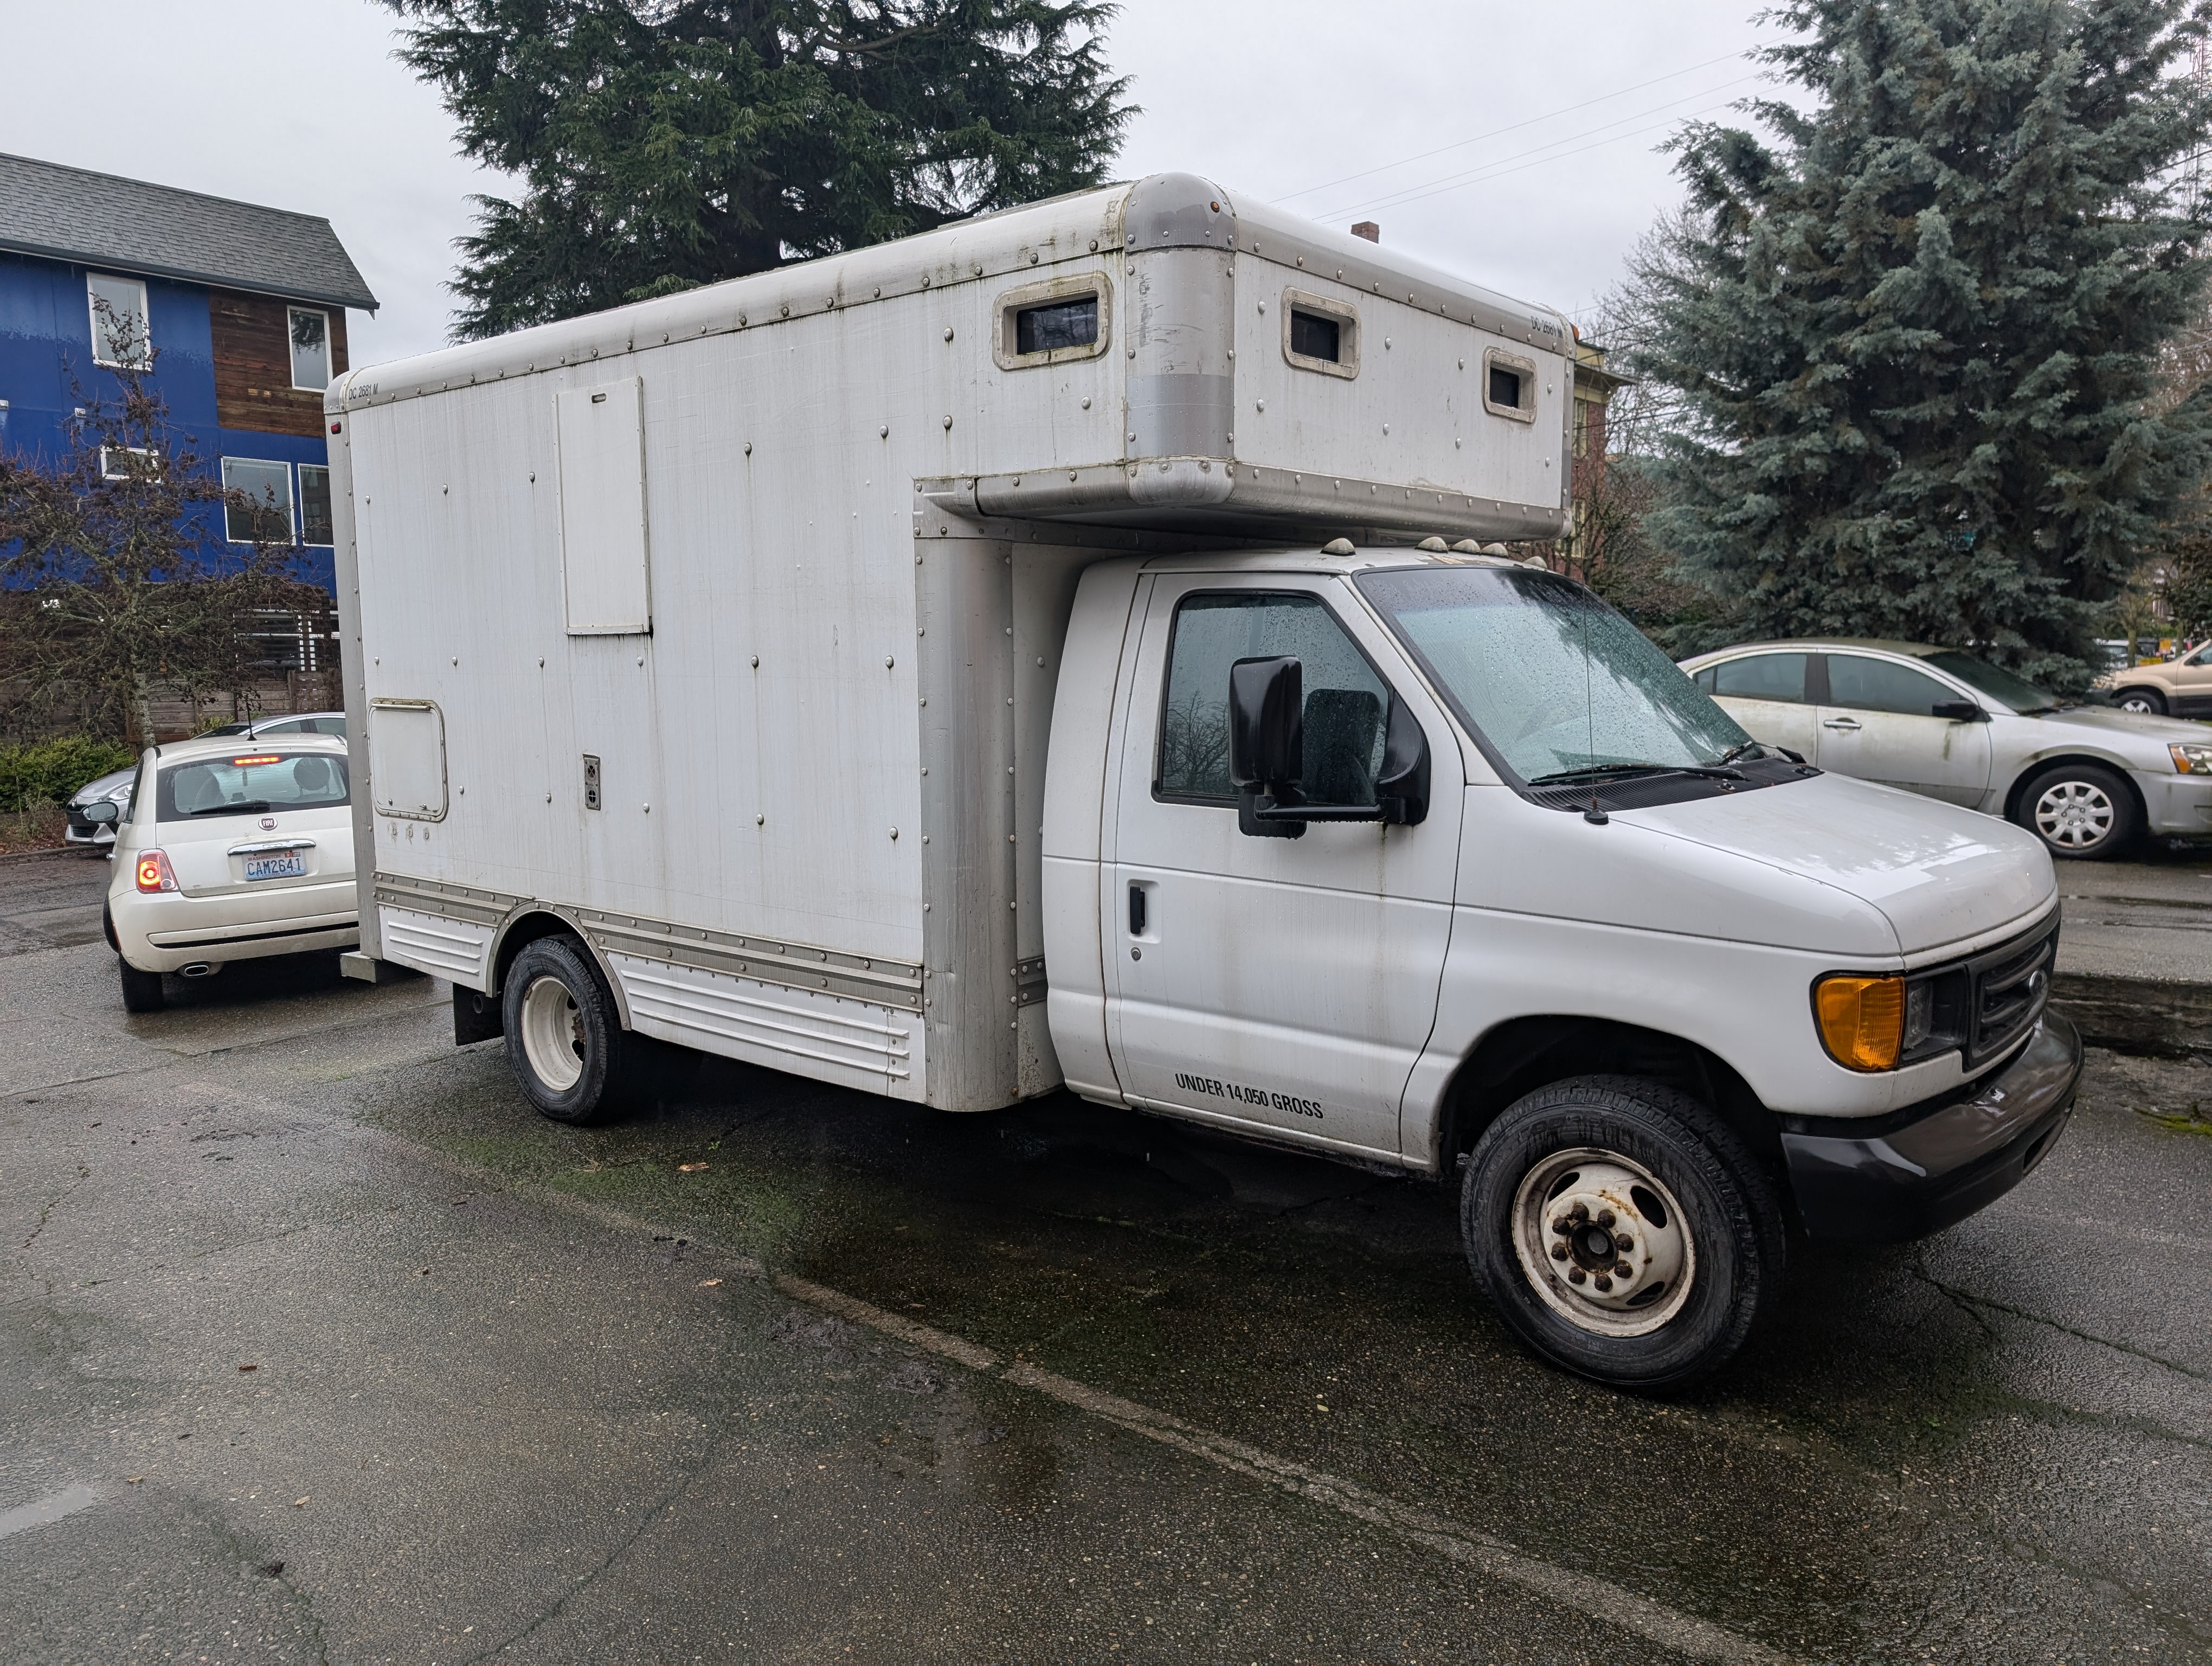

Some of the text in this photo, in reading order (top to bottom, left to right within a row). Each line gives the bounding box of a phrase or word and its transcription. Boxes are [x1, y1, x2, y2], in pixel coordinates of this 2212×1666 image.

[1531, 316, 1541, 331] DC
[1557, 324, 1563, 339] M
[349, 383, 378, 400] DC 2681 M
[247, 857, 300, 875] CAM2641
[1175, 1073, 1324, 1119] UNDER 14,050 GROSS
